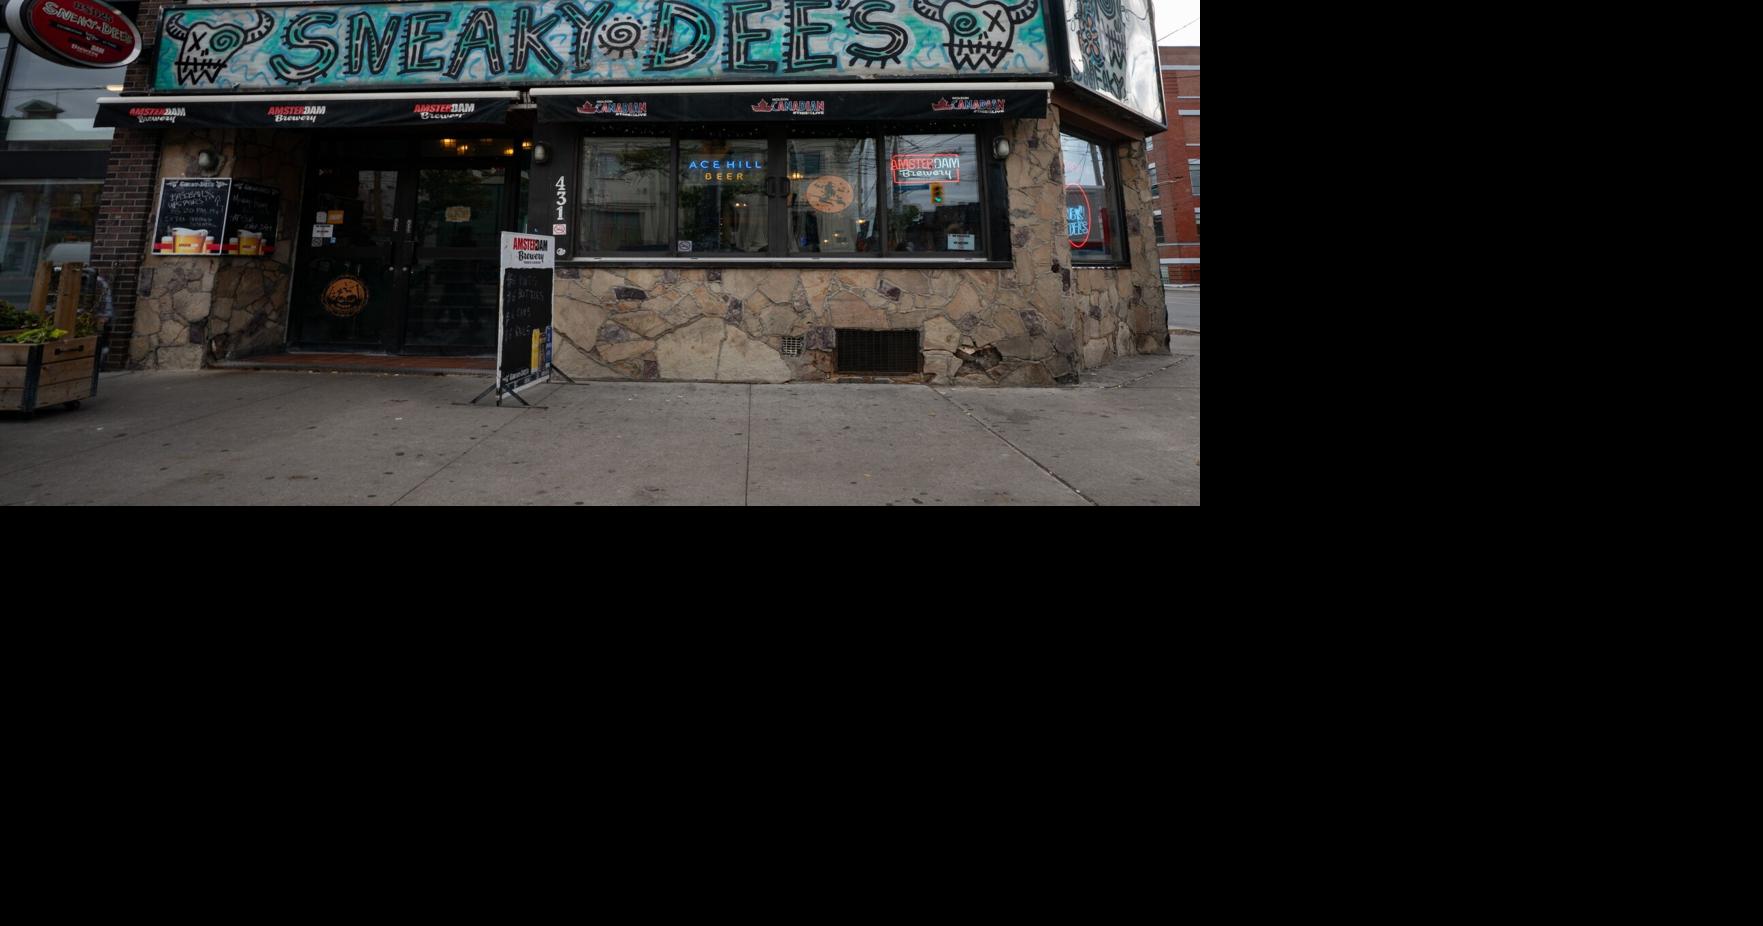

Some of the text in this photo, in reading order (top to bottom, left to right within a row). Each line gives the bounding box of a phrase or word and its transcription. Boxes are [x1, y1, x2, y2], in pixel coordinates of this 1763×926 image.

[269, 0, 908, 84] SNEAKY DEE'S
[267, 105, 326, 115] AMSTERDAM
[413, 103, 475, 113] AMSTERDAM
[595, 102, 647, 113] CANADIAN
[771, 101, 825, 112] CANADIAN
[951, 99, 1006, 110] CANADIAN
[129, 107, 186, 117] AMSTERDAM
[274, 114, 317, 123] Brewery
[688, 160, 762, 169] ACE HILL
[890, 157, 960, 171] AMSTERDAM
[704, 172, 744, 181] BEER
[899, 169, 952, 180] Brewery
[555, 175, 567, 221] 431
[512, 237, 548, 251] AMSTERDAM
[518, 251, 545, 263] Brewery
